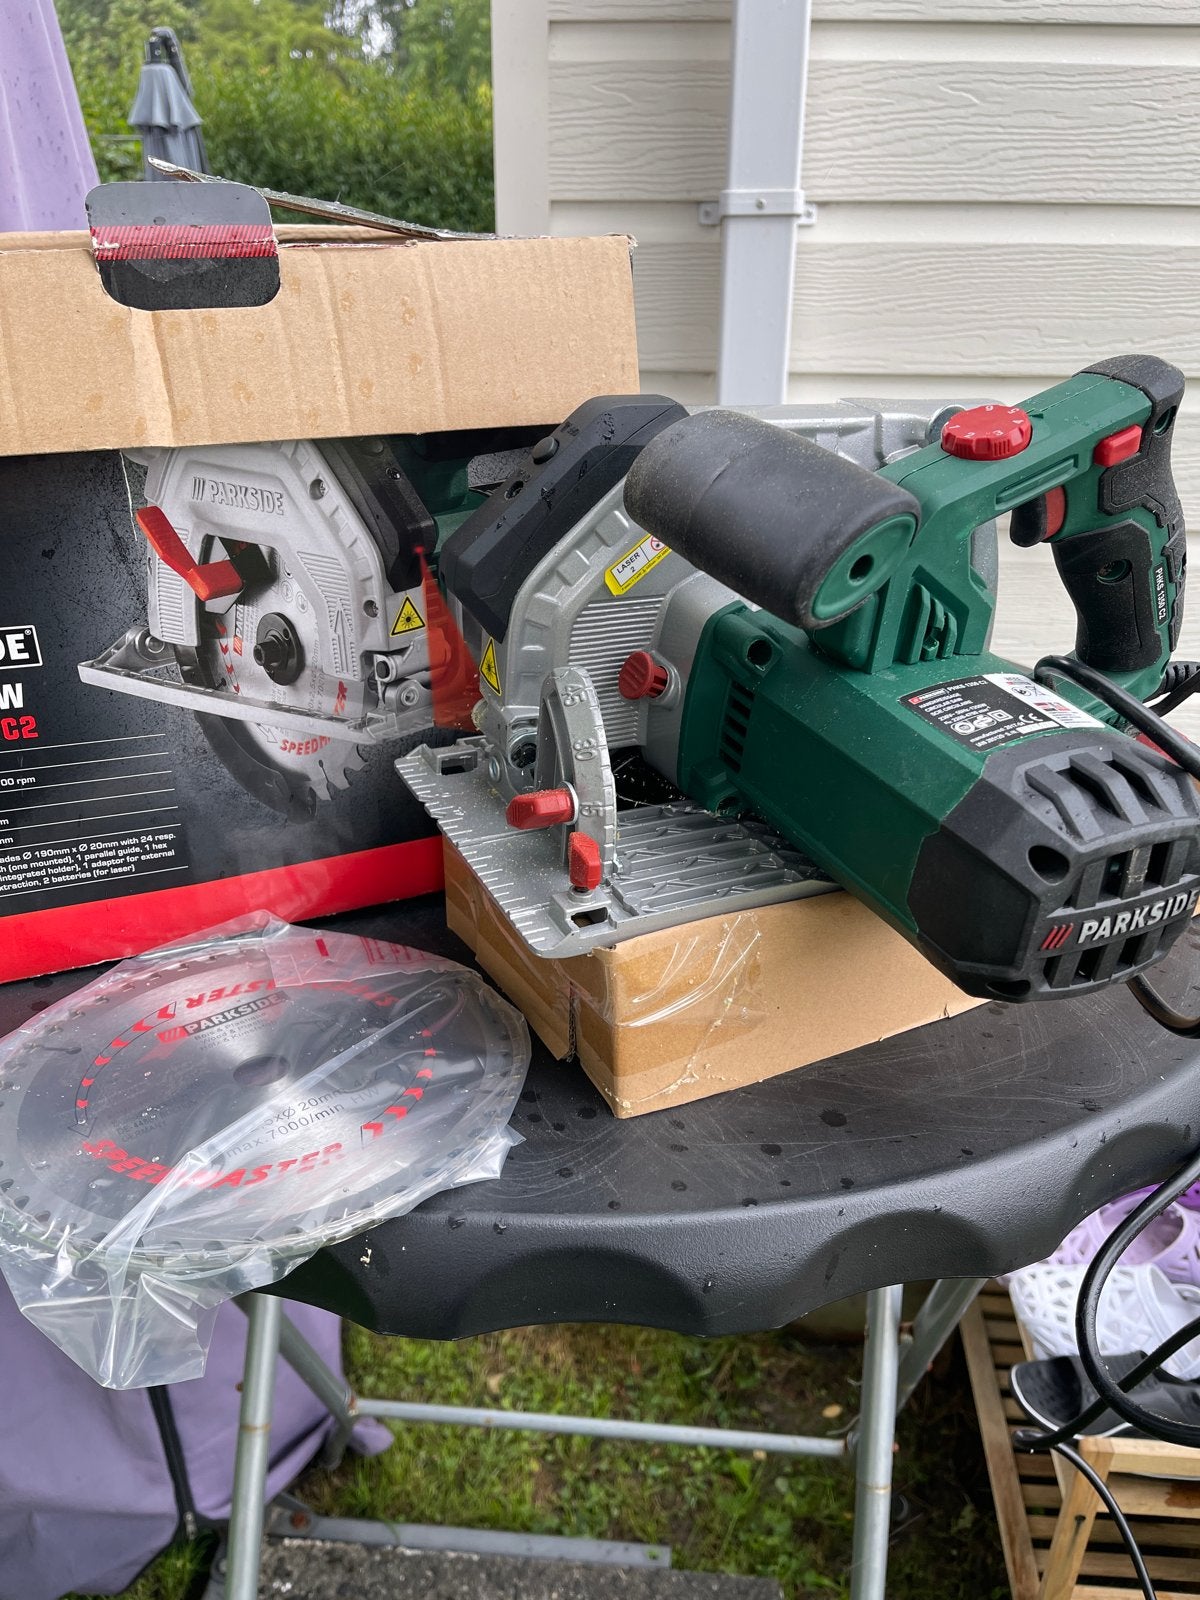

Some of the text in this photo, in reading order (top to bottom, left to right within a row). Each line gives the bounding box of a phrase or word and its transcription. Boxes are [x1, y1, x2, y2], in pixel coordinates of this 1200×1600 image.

[208, 479, 284, 516] PARKSIDE
[616, 552, 640, 574] LASER
[1155, 567, 1164, 591] PHKS
[1158, 607, 1166, 620] C2
[1, 715, 38, 740] C2
[17, 775, 36, 786] rpm
[8, 863, 28, 873] (one
[84, 849, 116, 861] parallel
[118, 846, 142, 857] guide,
[152, 842, 167, 850] hex
[34, 848, 70, 858] 190mm
[90, 841, 119, 850] 20mm
[120, 837, 139, 846] with
[140, 834, 153, 843] 24
[155, 833, 176, 841] resp.
[91, 857, 125, 868] adaptor
[141, 849, 175, 860] external
[52, 871, 91, 883] batteries
[93, 868, 109, 878] (for
[111, 864, 135, 874] laser)
[1078, 888, 1200, 944] PARKSIDE
[183, 991, 282, 1034] PARKSIDE
